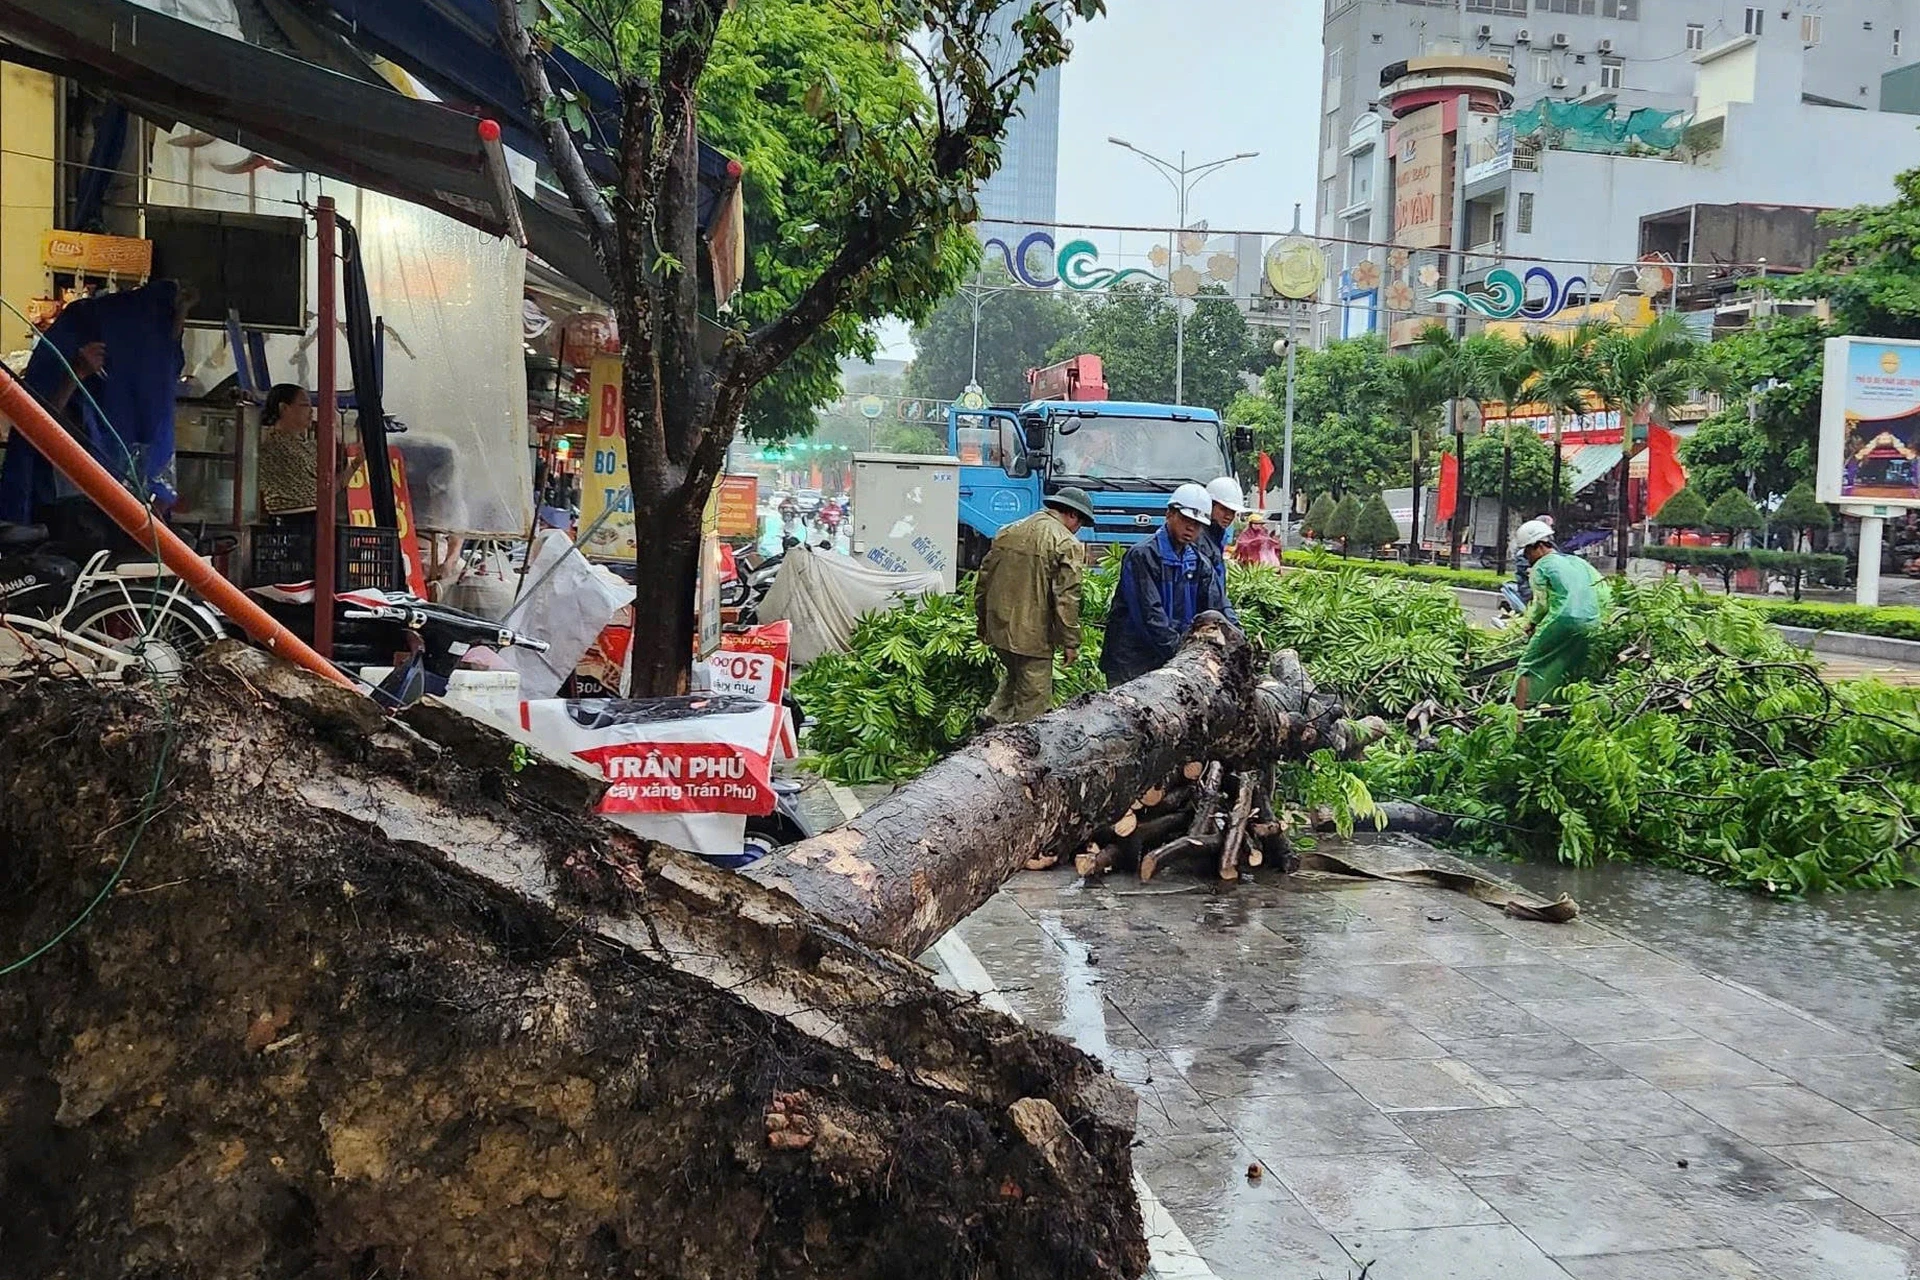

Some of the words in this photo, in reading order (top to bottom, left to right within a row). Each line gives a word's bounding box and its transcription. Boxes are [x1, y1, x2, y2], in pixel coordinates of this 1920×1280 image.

[594, 446, 616, 474] BÒ
[609, 749, 682, 778] TRẦN
[689, 751, 746, 779] PHÚ
[641, 782, 682, 800] xăng
[723, 783, 757, 801] Phú)
